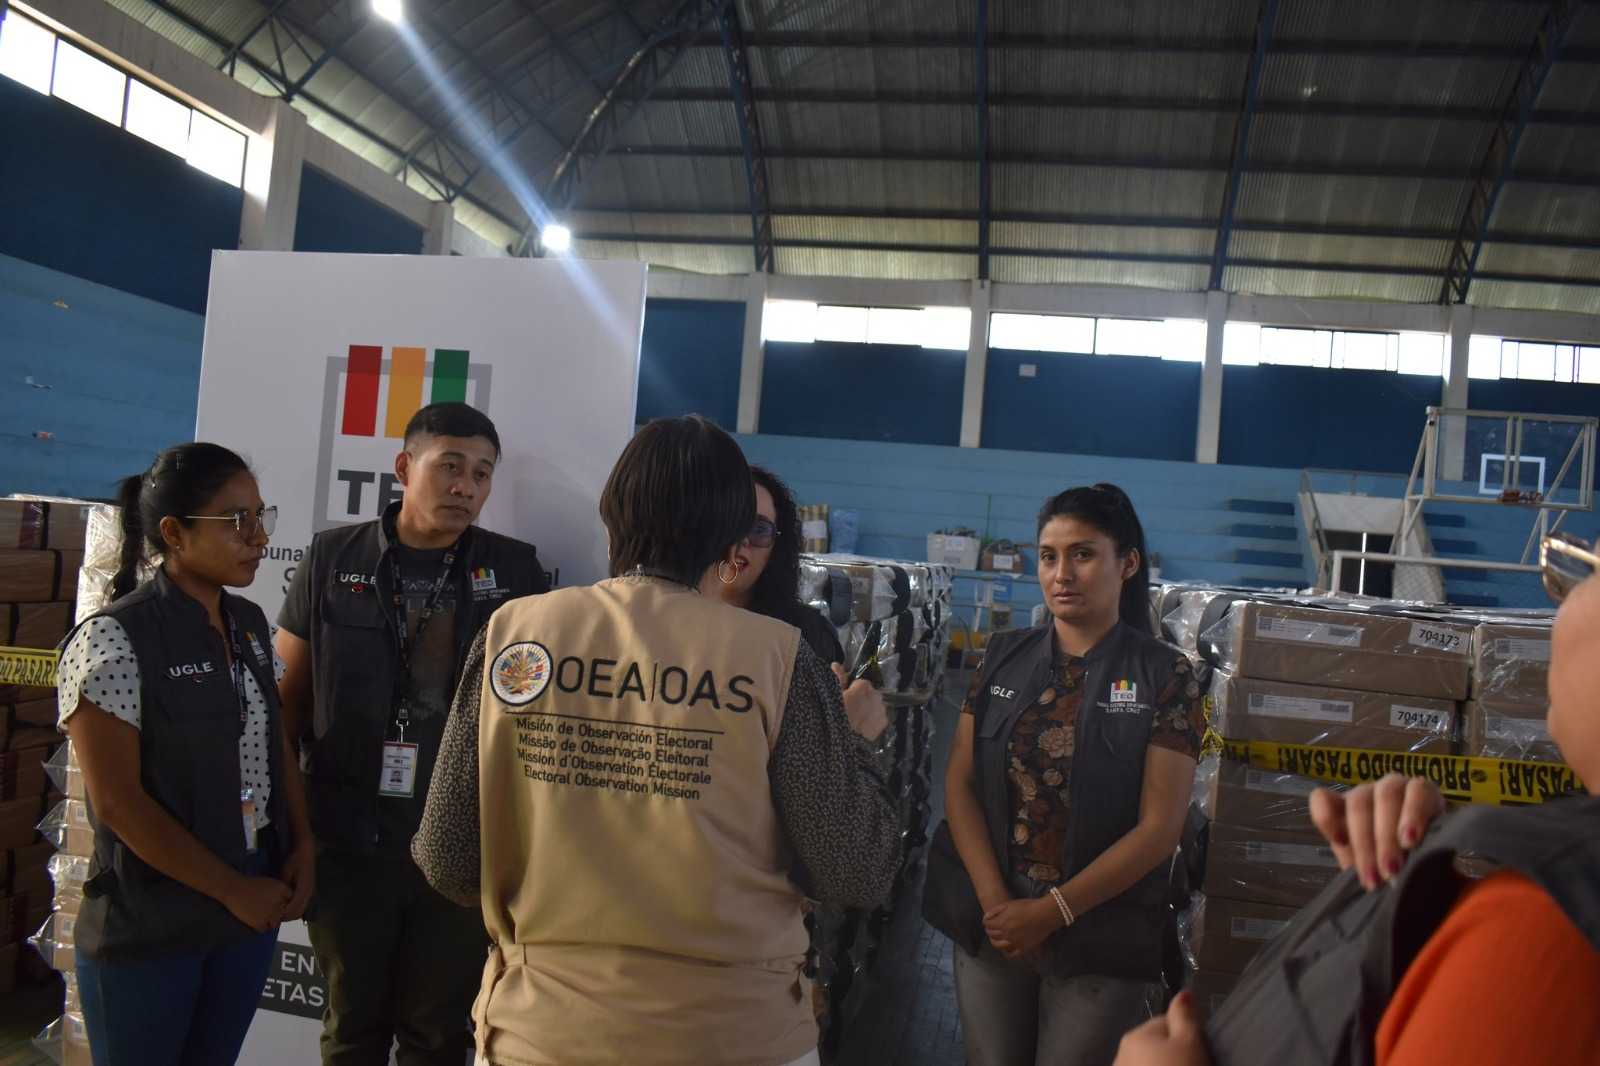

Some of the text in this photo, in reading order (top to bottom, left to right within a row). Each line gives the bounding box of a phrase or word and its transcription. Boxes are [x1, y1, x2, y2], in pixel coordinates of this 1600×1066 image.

[338, 469, 404, 516] TE
[340, 572, 376, 585] UGLE
[169, 662, 214, 677] UGLE
[1397, 710, 1438, 724] 704174
[517, 718, 713, 750] Misión de Observación Electoral
[519, 733, 709, 767] Missão de Observação Eleitoral
[517, 747, 712, 784] Mission d'Observation Électorale
[1278, 747, 1352, 780] PASAR!
[1357, 752, 1471, 791] PROHIBIDO
[1499, 761, 1575, 798] PASAR!
[524, 764, 699, 800] Electoral Observation Mission
[281, 950, 315, 976] EN
